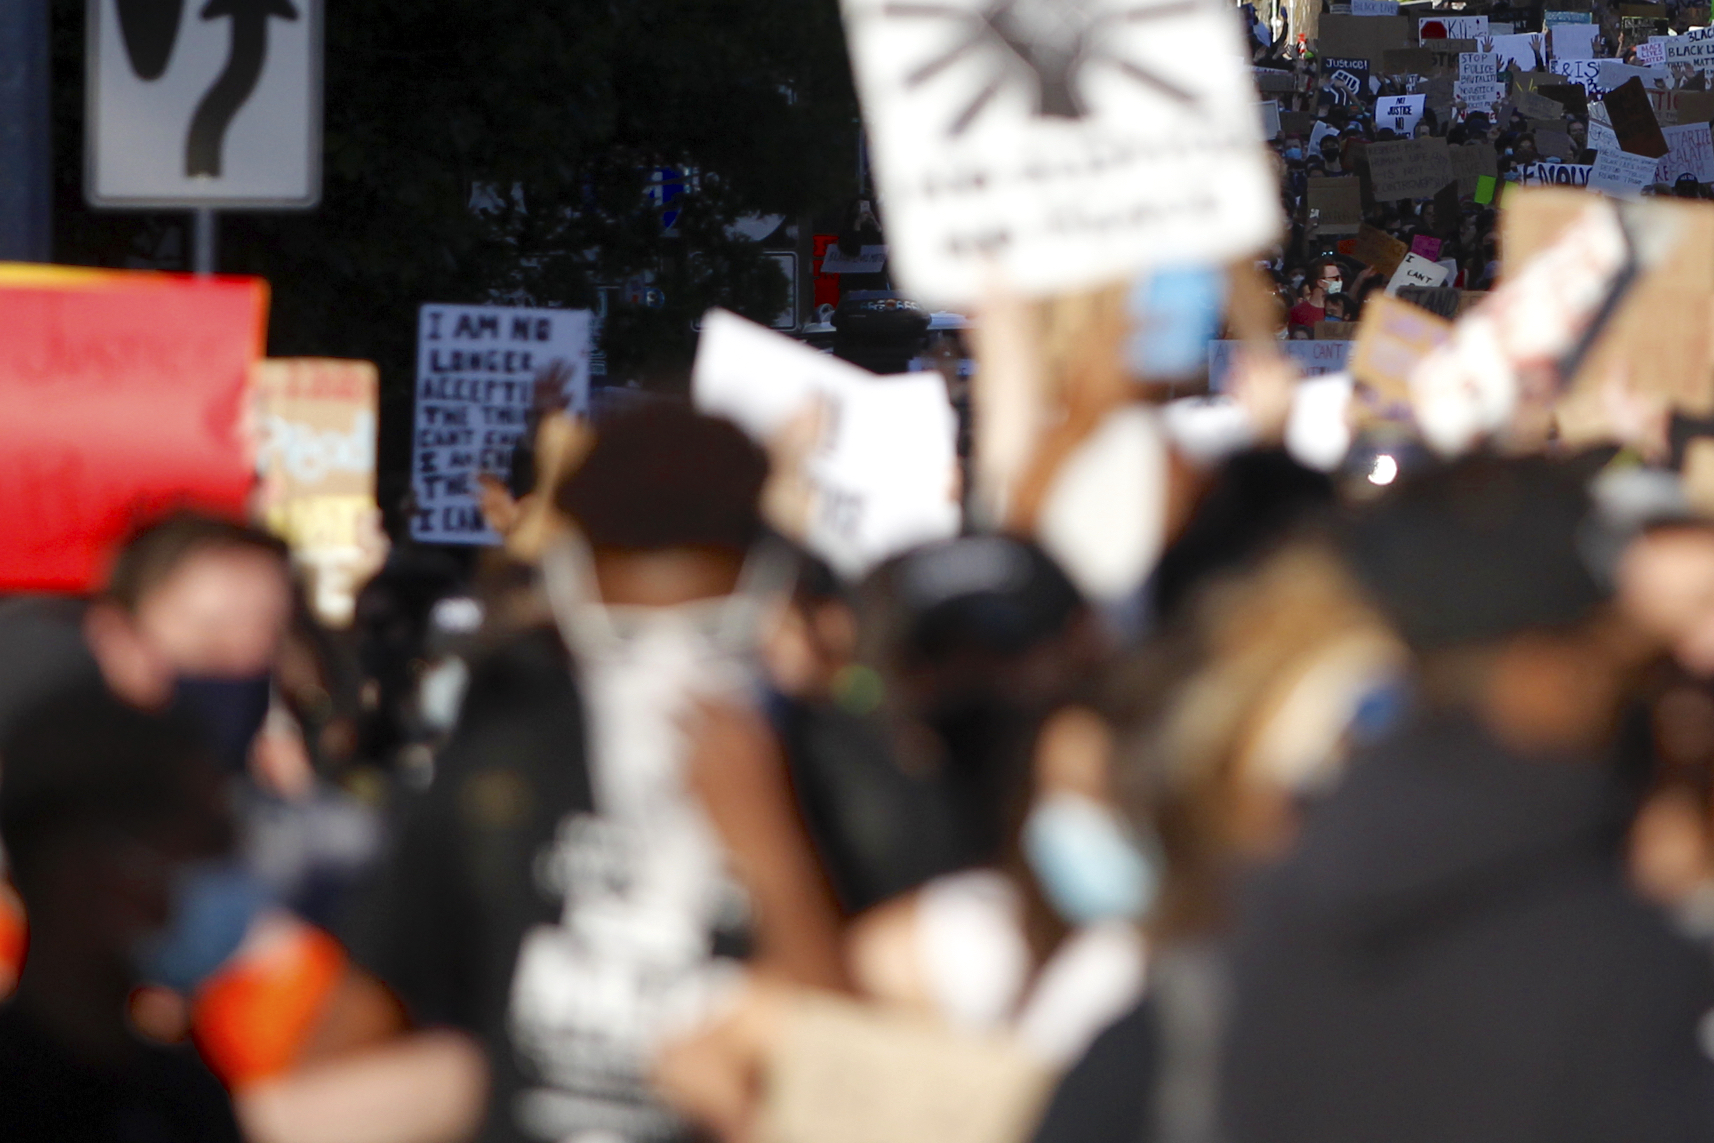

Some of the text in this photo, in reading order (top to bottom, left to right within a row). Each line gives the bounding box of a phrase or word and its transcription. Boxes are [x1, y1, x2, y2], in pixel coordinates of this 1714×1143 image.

[1668, 45, 1704, 57] BLACK
[1461, 53, 1488, 64] STOP
[1463, 64, 1494, 74] POLICE
[1387, 106, 1412, 116] JUSTICE
[1395, 117, 1404, 130] NO
[1522, 164, 1592, 188] ENOU
[1405, 254, 1415, 263] I
[428, 311, 551, 342] I AM NO
[430, 348, 532, 374] LONGER
[421, 376, 528, 402] ACCEPTI
